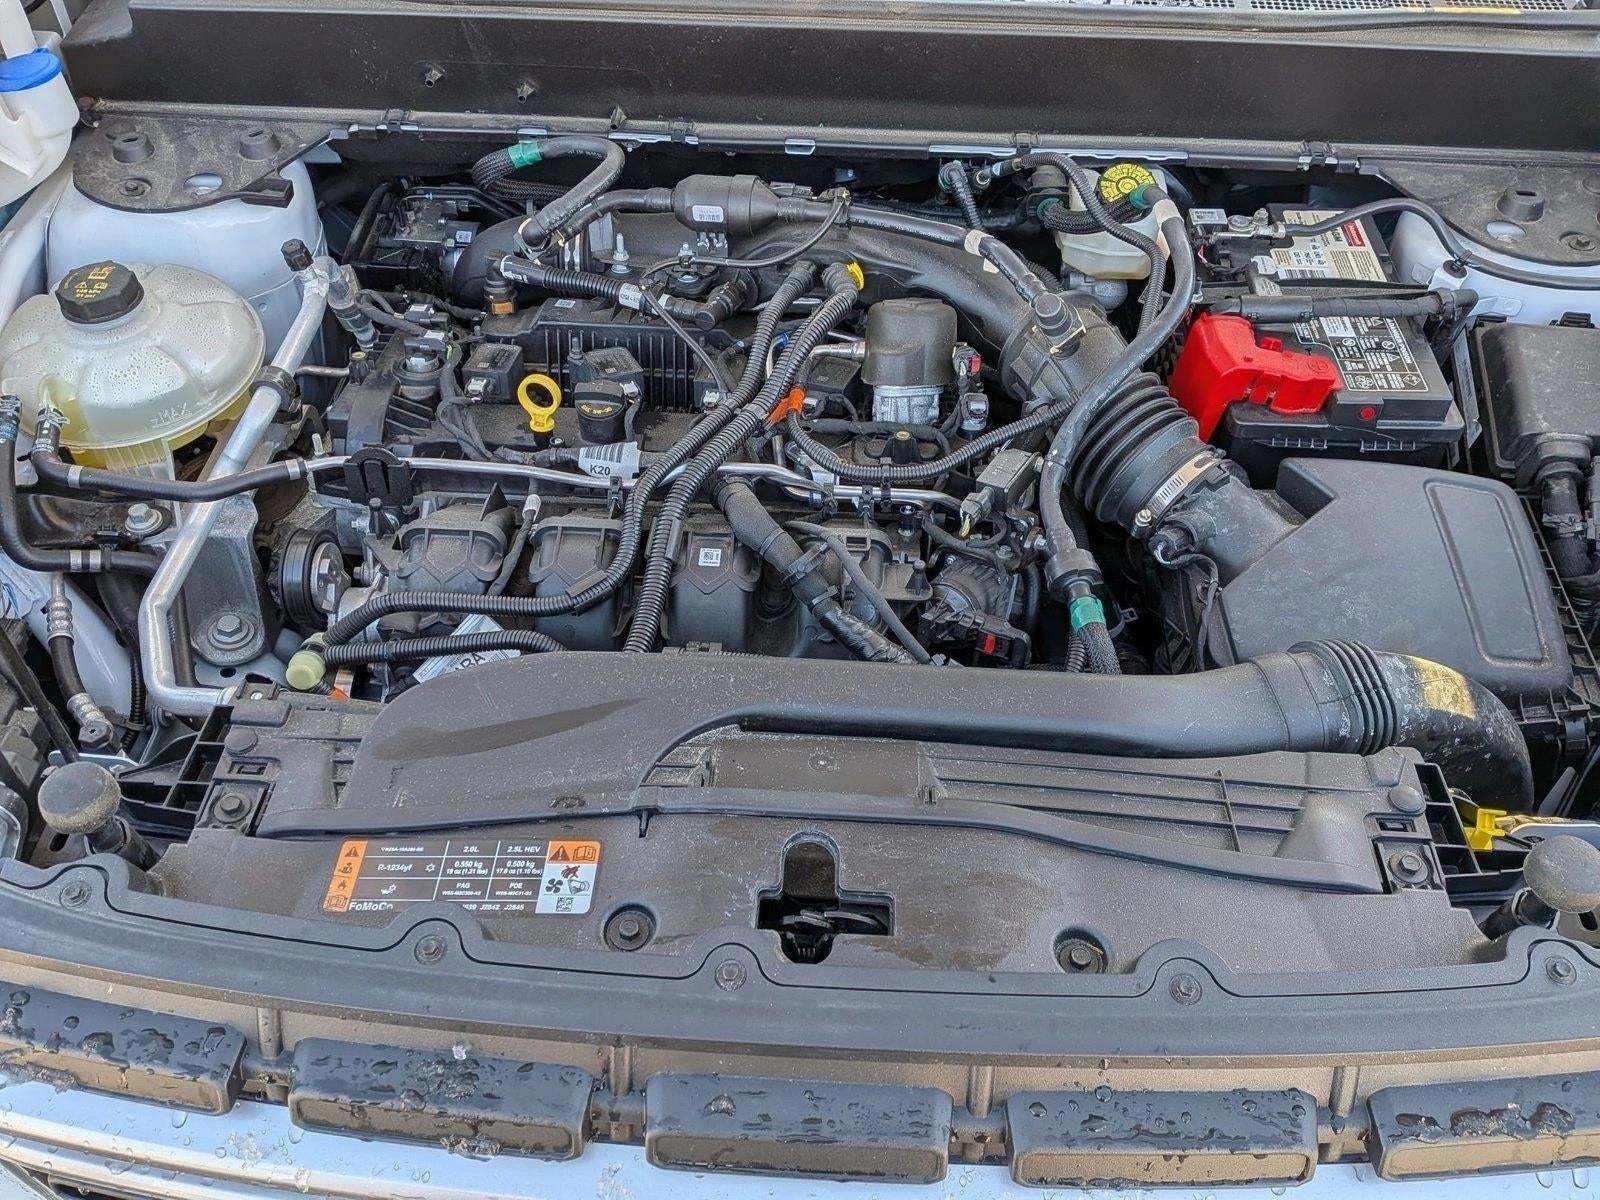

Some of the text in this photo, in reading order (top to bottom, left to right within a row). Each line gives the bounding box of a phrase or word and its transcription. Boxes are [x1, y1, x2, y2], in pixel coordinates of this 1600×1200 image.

[159, 401, 187, 424] MAX
[590, 464, 611, 476] K20
[377, 863, 413, 872] R-1234yf
[473, 861, 484, 869] kg
[525, 861, 535, 869] kg
[348, 902, 394, 911] FoMoCo
